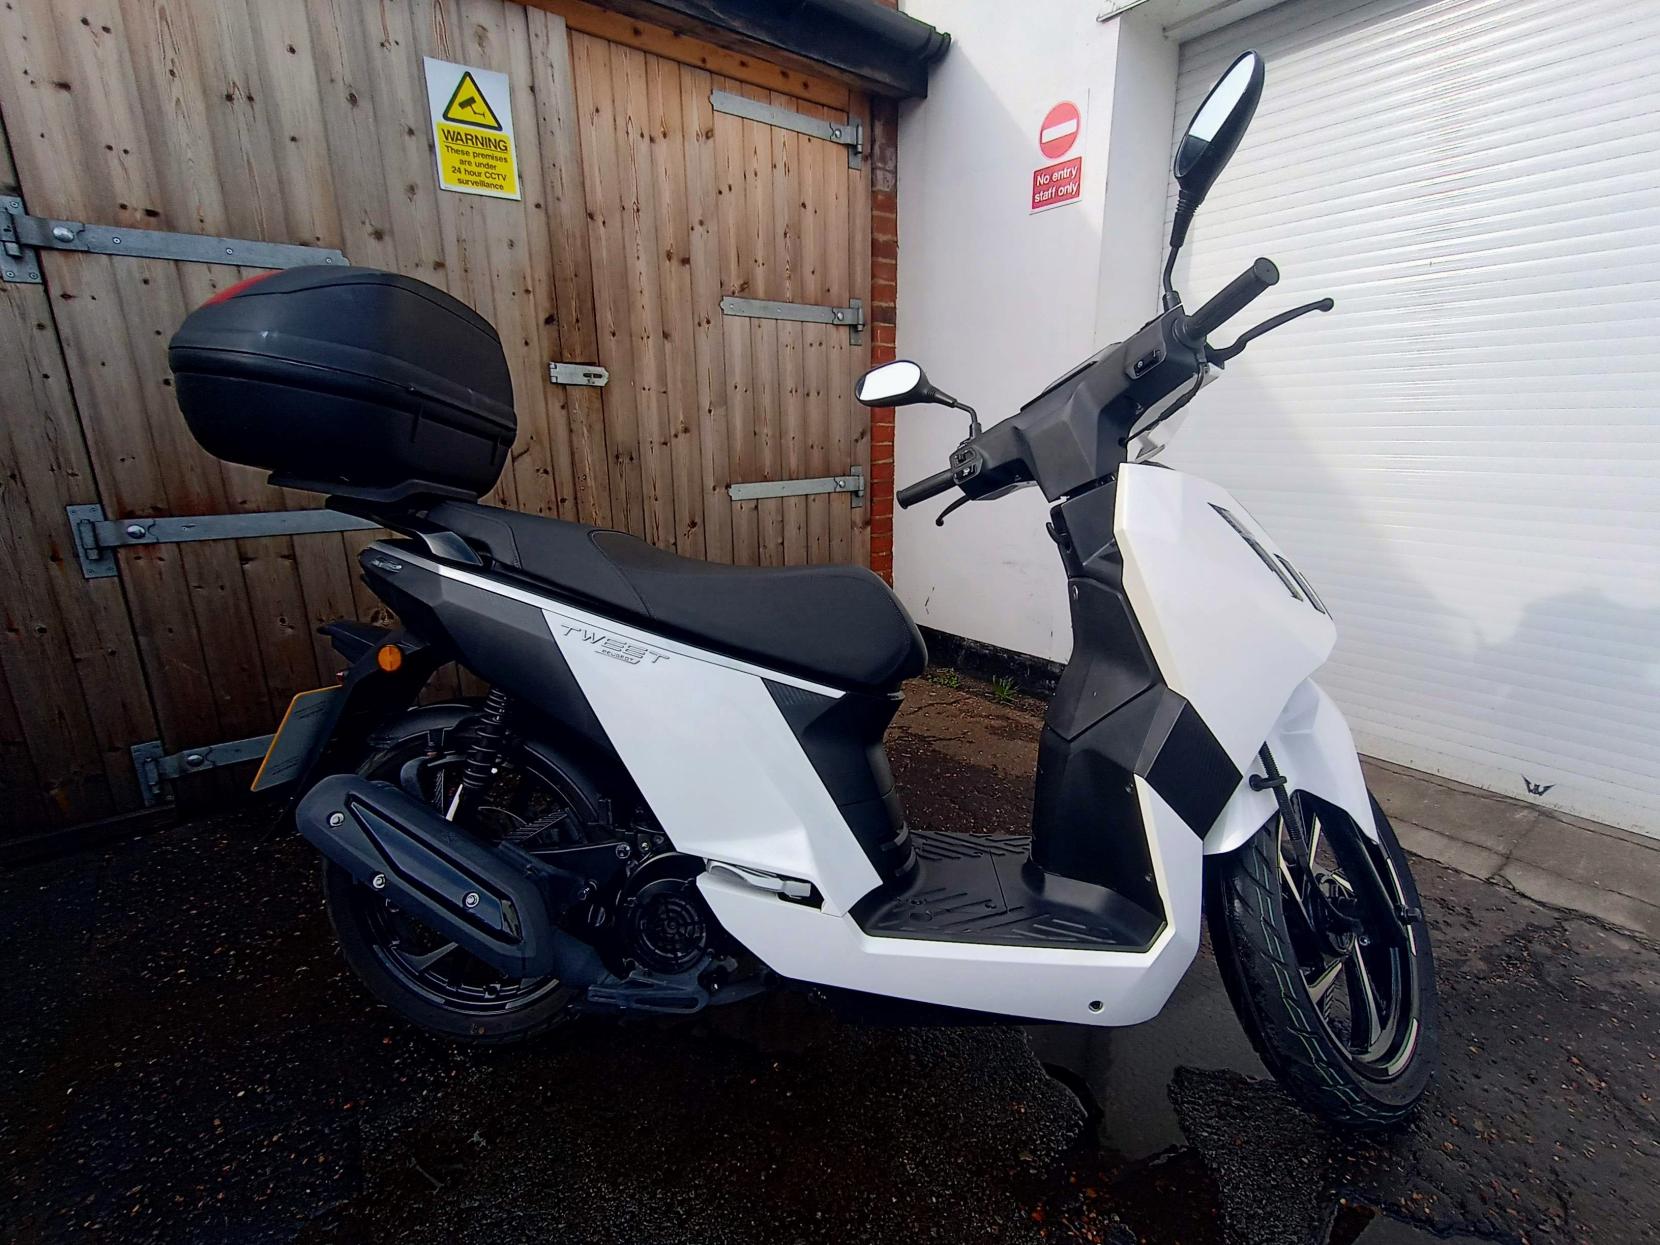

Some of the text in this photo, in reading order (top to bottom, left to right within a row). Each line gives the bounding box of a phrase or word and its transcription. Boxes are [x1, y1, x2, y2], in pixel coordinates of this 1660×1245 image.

[442, 128, 508, 151] WARNING
[444, 145, 508, 163] These premises
[452, 165, 507, 182] 24 hour CCTV
[459, 158, 497, 170] are under
[457, 178, 504, 190] surveillance
[1036, 166, 1078, 187] No entry
[1034, 181, 1079, 203] staff only
[561, 624, 670, 664] TWEET
